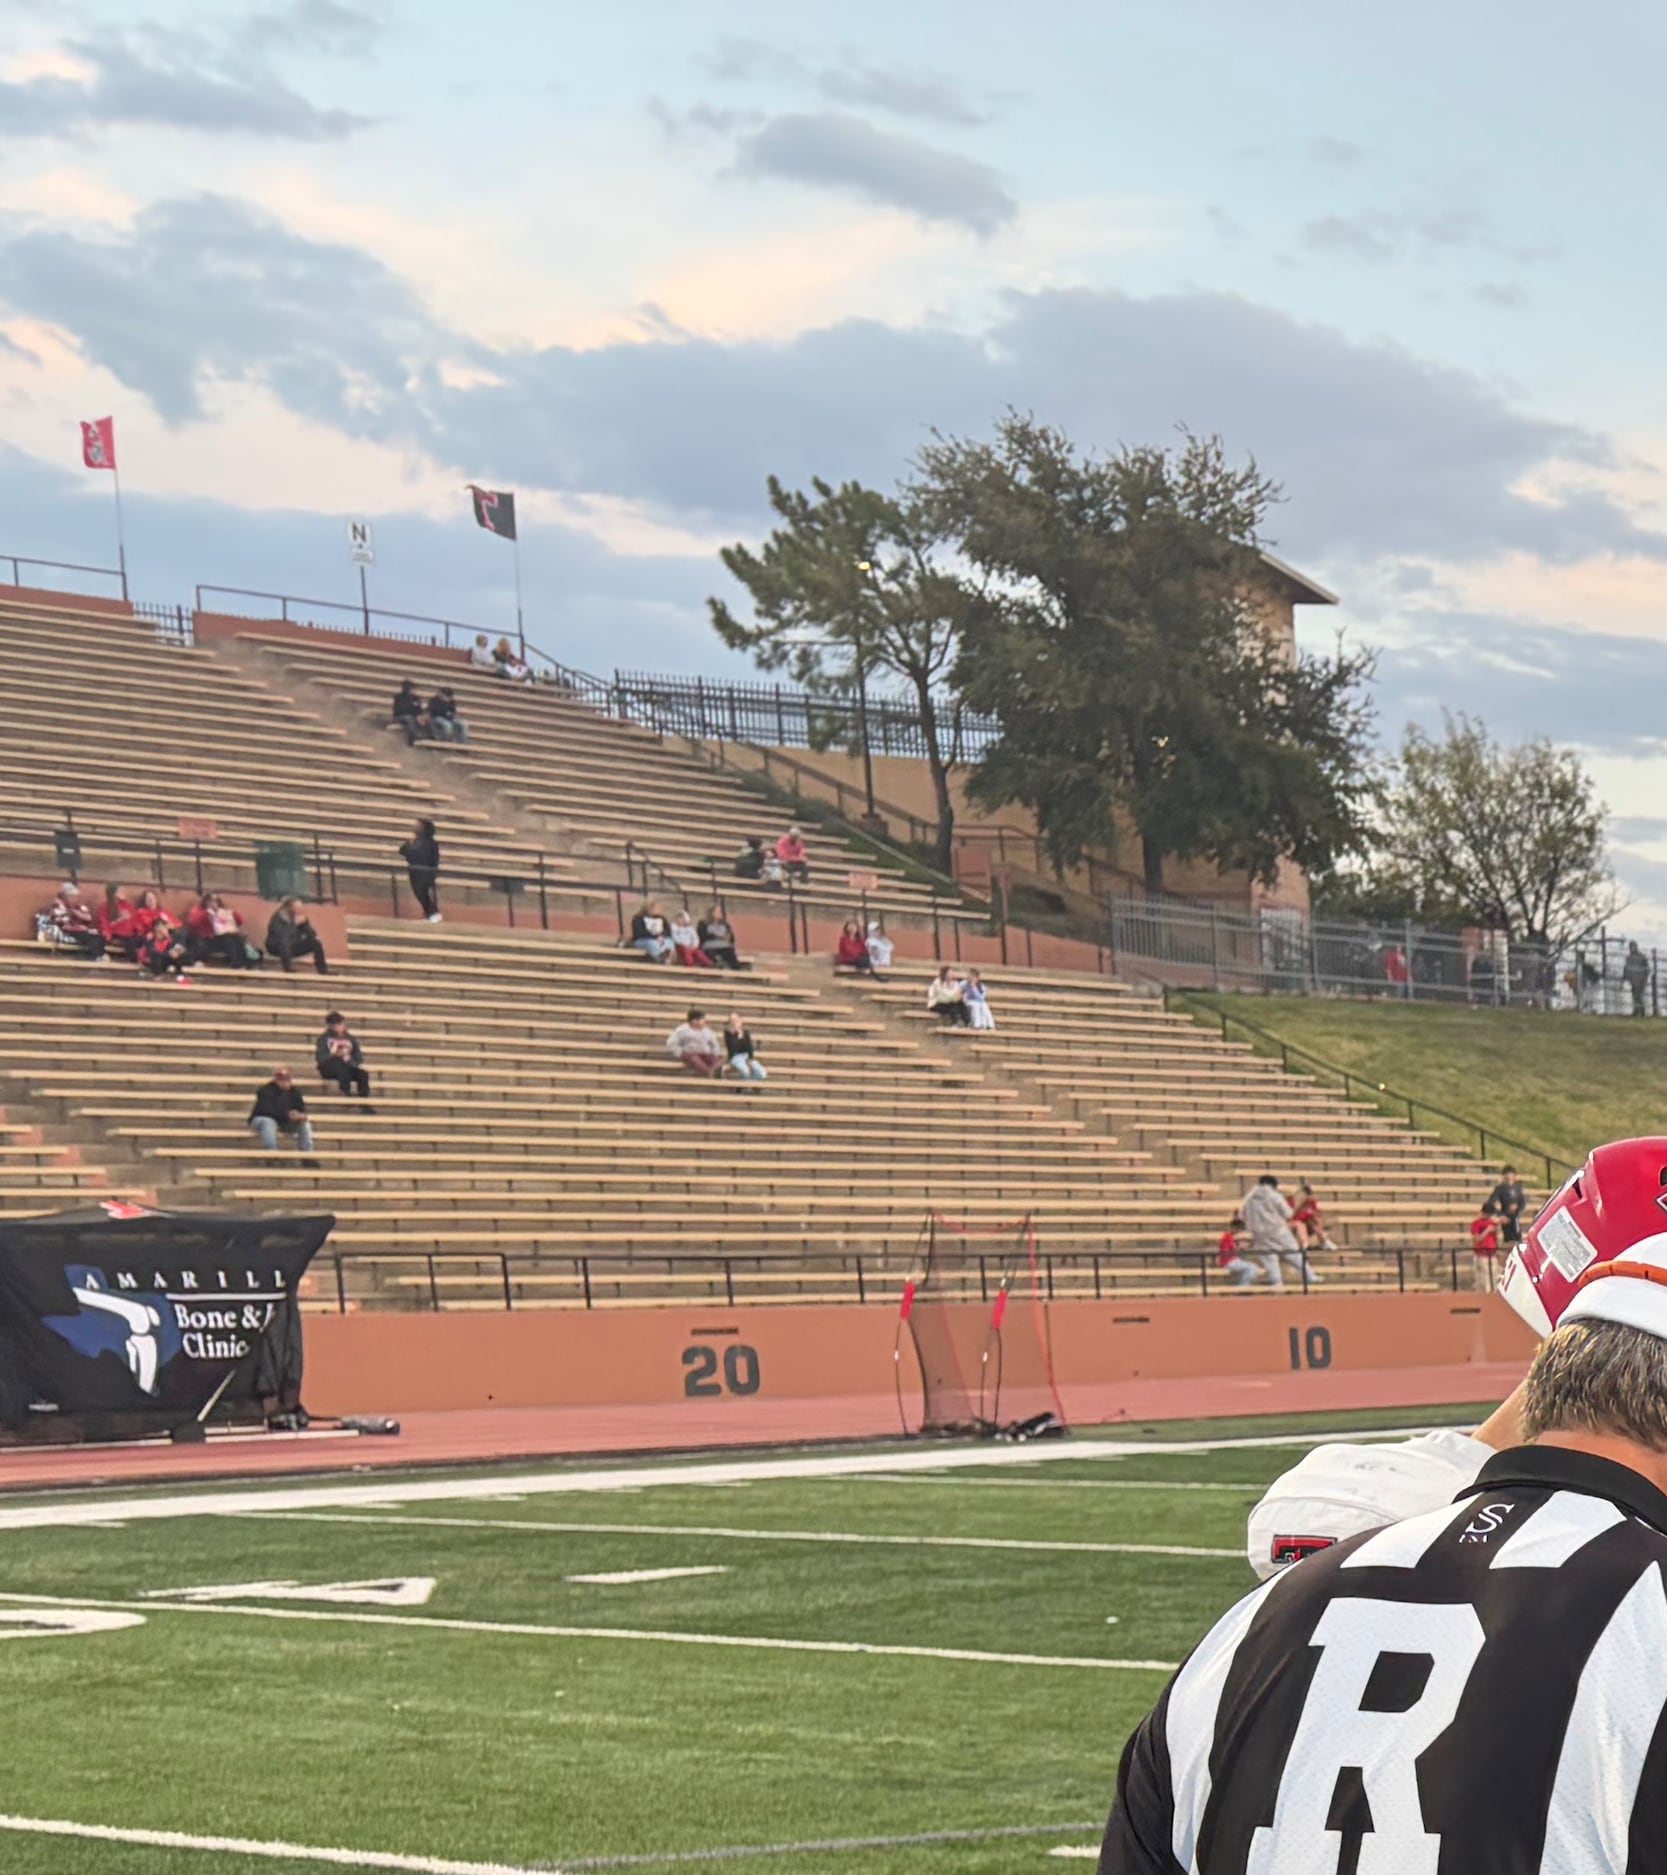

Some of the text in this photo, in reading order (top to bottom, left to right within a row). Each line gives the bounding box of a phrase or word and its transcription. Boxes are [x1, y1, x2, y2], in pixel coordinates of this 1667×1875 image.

[352, 521, 367, 542] N
[174, 1303, 238, 1330] Bone
[182, 1332, 250, 1360] Clinic
[1287, 1325, 1332, 1370] 10
[681, 1344, 761, 1397] 20
